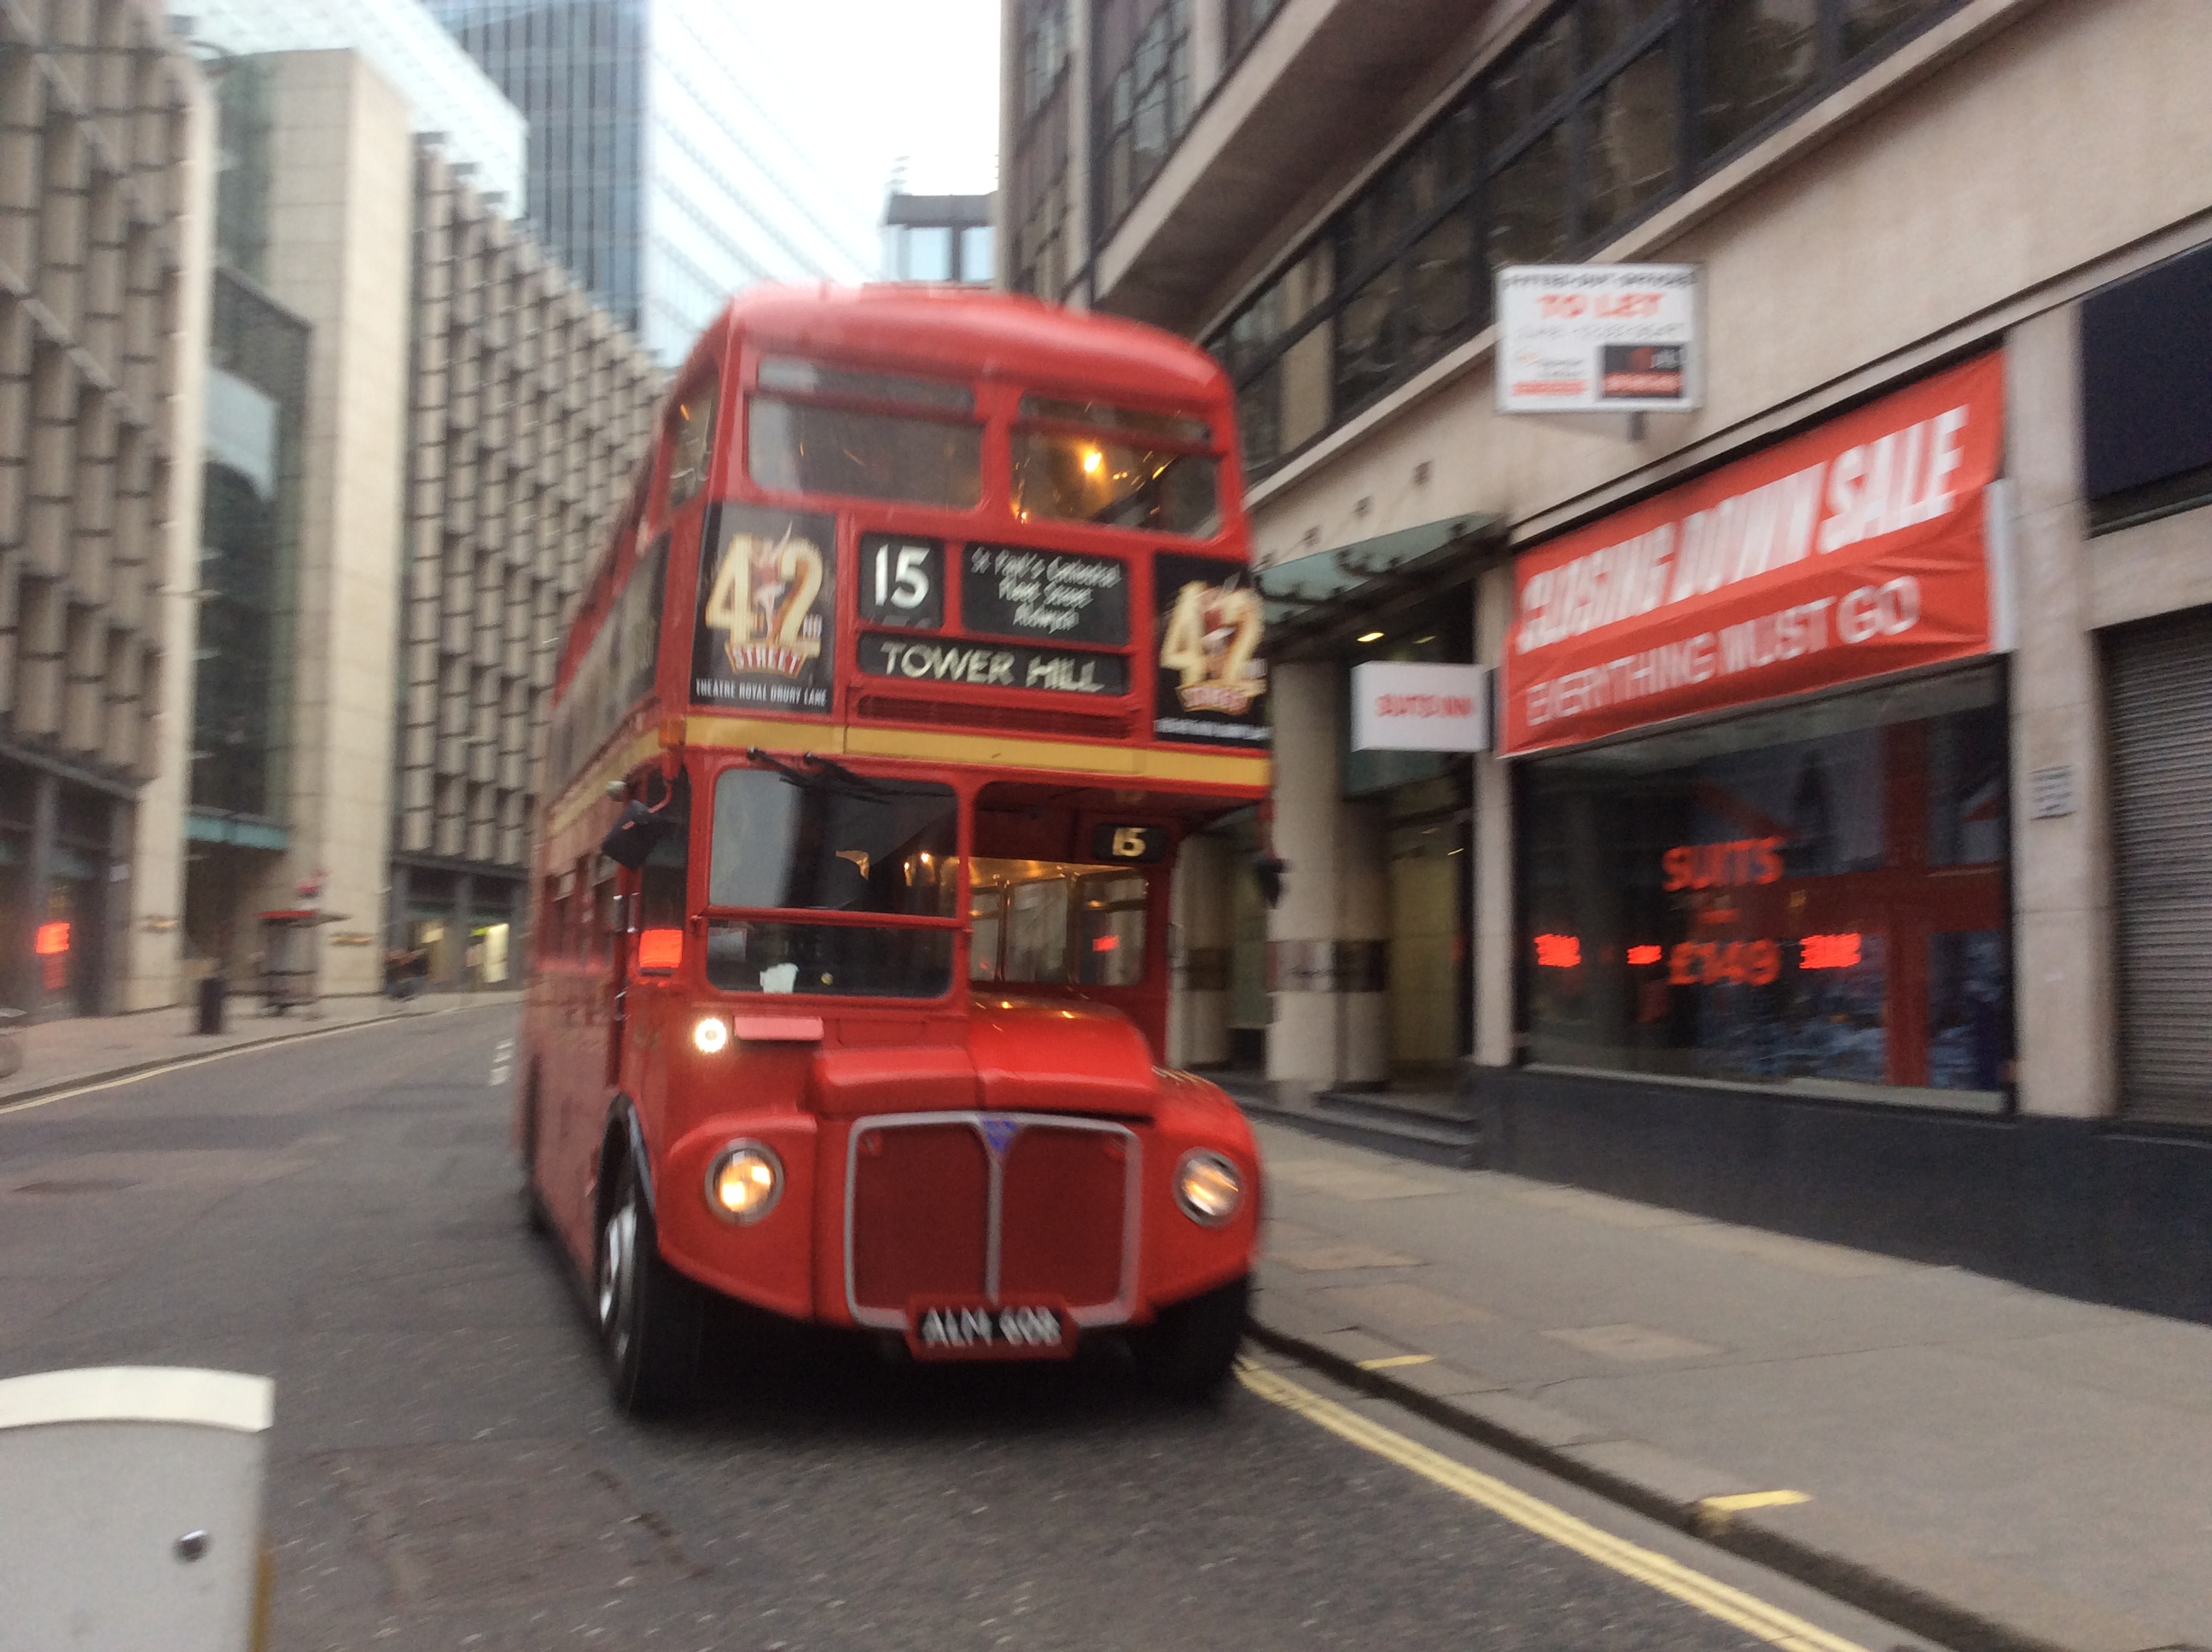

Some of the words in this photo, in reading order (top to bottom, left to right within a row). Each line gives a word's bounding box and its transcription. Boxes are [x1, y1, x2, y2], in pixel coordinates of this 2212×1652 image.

[1516, 521, 1678, 655] CLOSING
[1670, 461, 1829, 605] DOWN
[1818, 404, 1971, 554] SALE
[875, 544, 930, 609] 15
[731, 644, 802, 674] STREET
[881, 642, 1016, 685] TOWER
[1026, 656, 1105, 693] HILL
[1526, 631, 1715, 727] EVERYTHING
[1717, 596, 1838, 677] MUST
[1837, 574, 1921, 644] GO
[696, 678, 736, 699] THEATRE
[739, 681, 767, 701] ROYAL
[804, 688, 828, 707] LANE
[1662, 836, 1784, 893] SUITS
